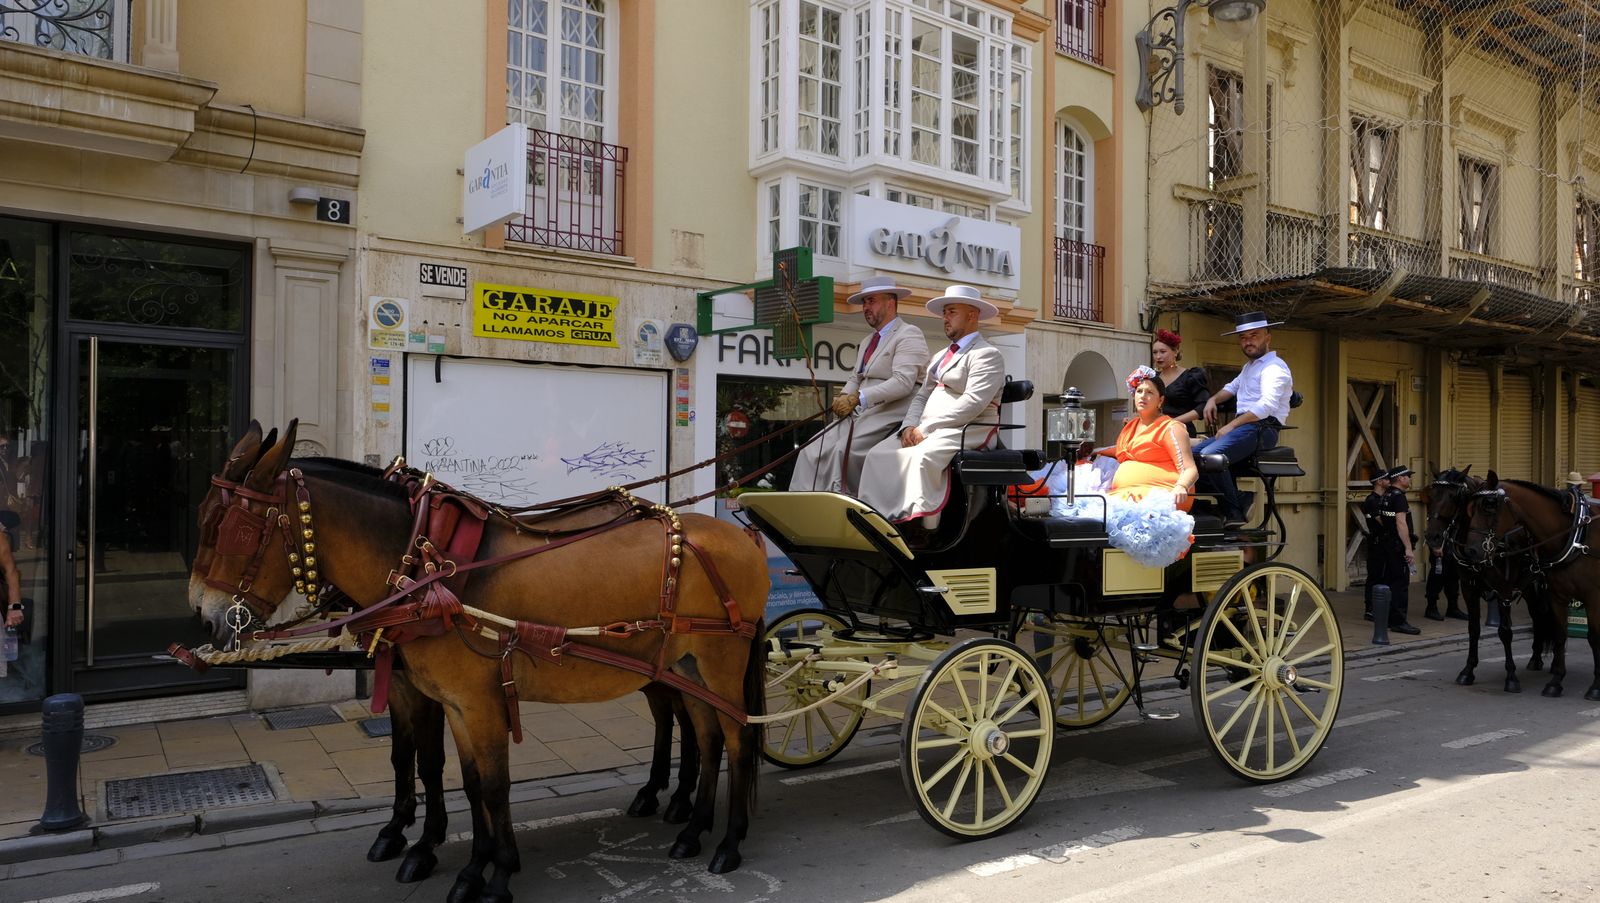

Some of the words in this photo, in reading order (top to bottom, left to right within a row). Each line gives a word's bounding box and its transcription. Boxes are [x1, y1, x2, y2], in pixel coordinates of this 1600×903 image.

[328, 200, 340, 221] 8
[421, 264, 433, 283] SE
[434, 266, 466, 287] VENDE
[483, 290, 612, 320] GARAJE
[493, 312, 518, 322] NO
[526, 316, 604, 330] APARCAR
[482, 323, 566, 339] LLAMAMOS
[571, 329, 611, 342] GRUA
[718, 333, 860, 372] FARAC
